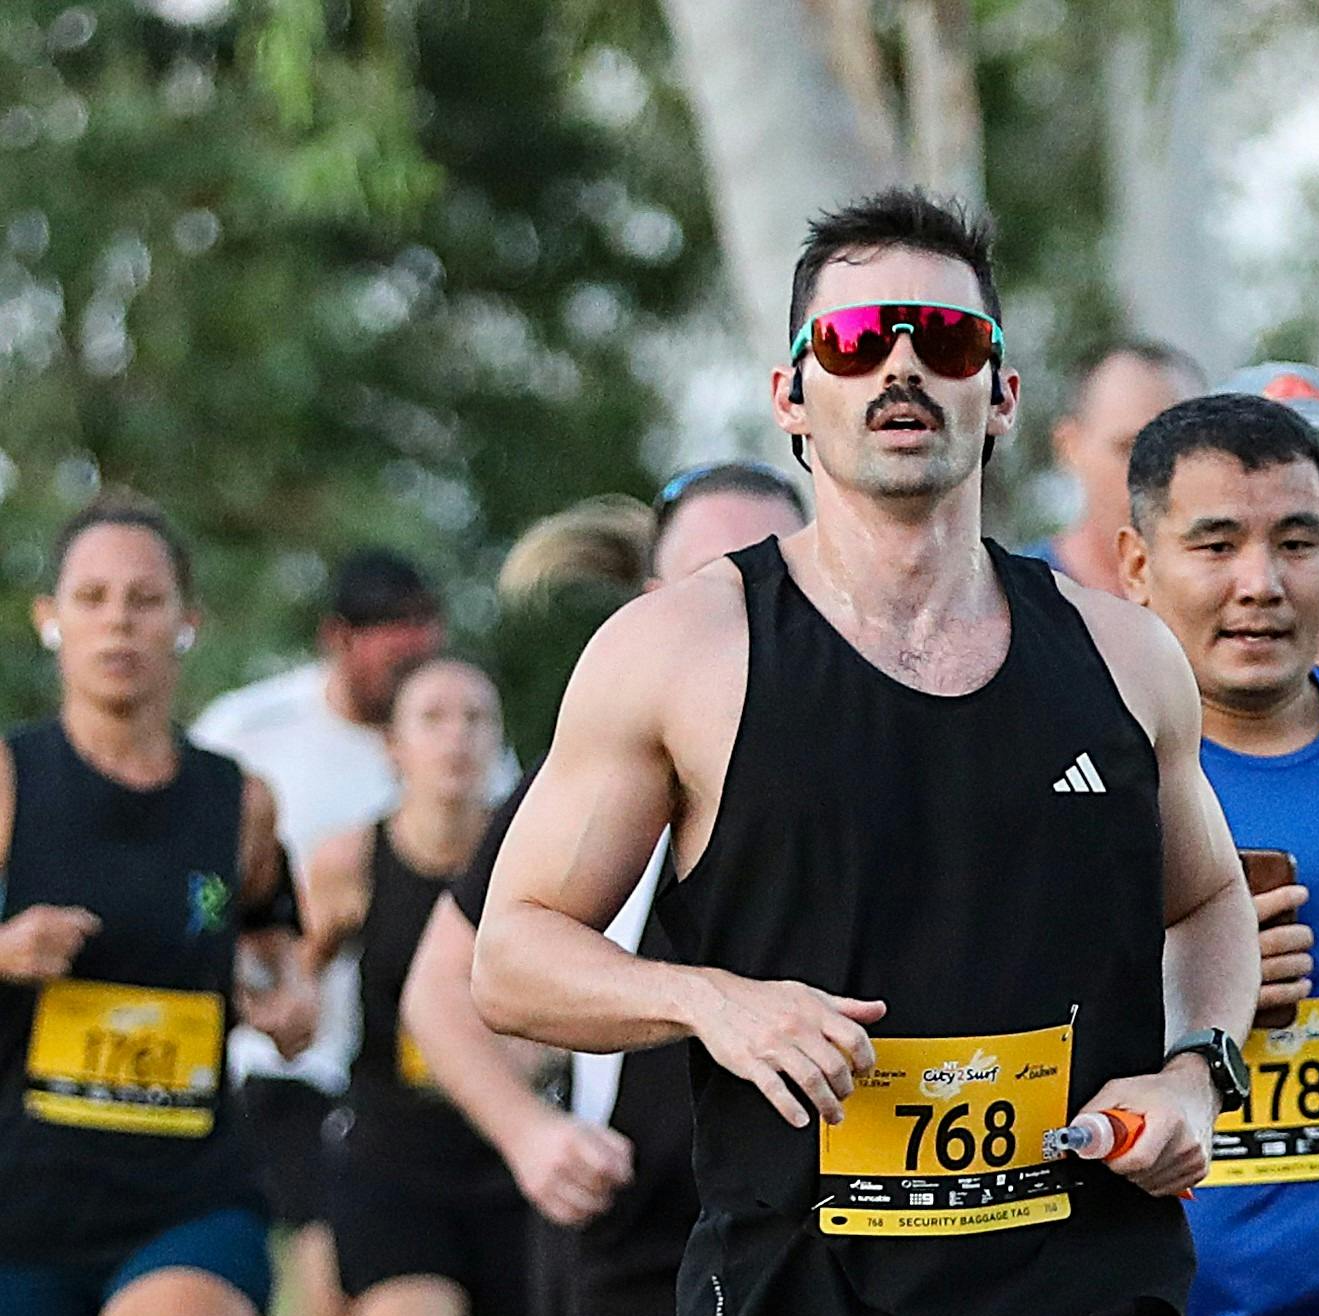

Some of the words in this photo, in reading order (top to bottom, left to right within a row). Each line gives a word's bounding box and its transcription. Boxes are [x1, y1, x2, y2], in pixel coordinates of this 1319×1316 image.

[895, 1100, 1016, 1171] 768
[867, 1217, 884, 1228] 768
[898, 1216, 957, 1228] SECURITY
[960, 1211, 1008, 1226] BAGGAGE
[1010, 1206, 1031, 1218] TAG
